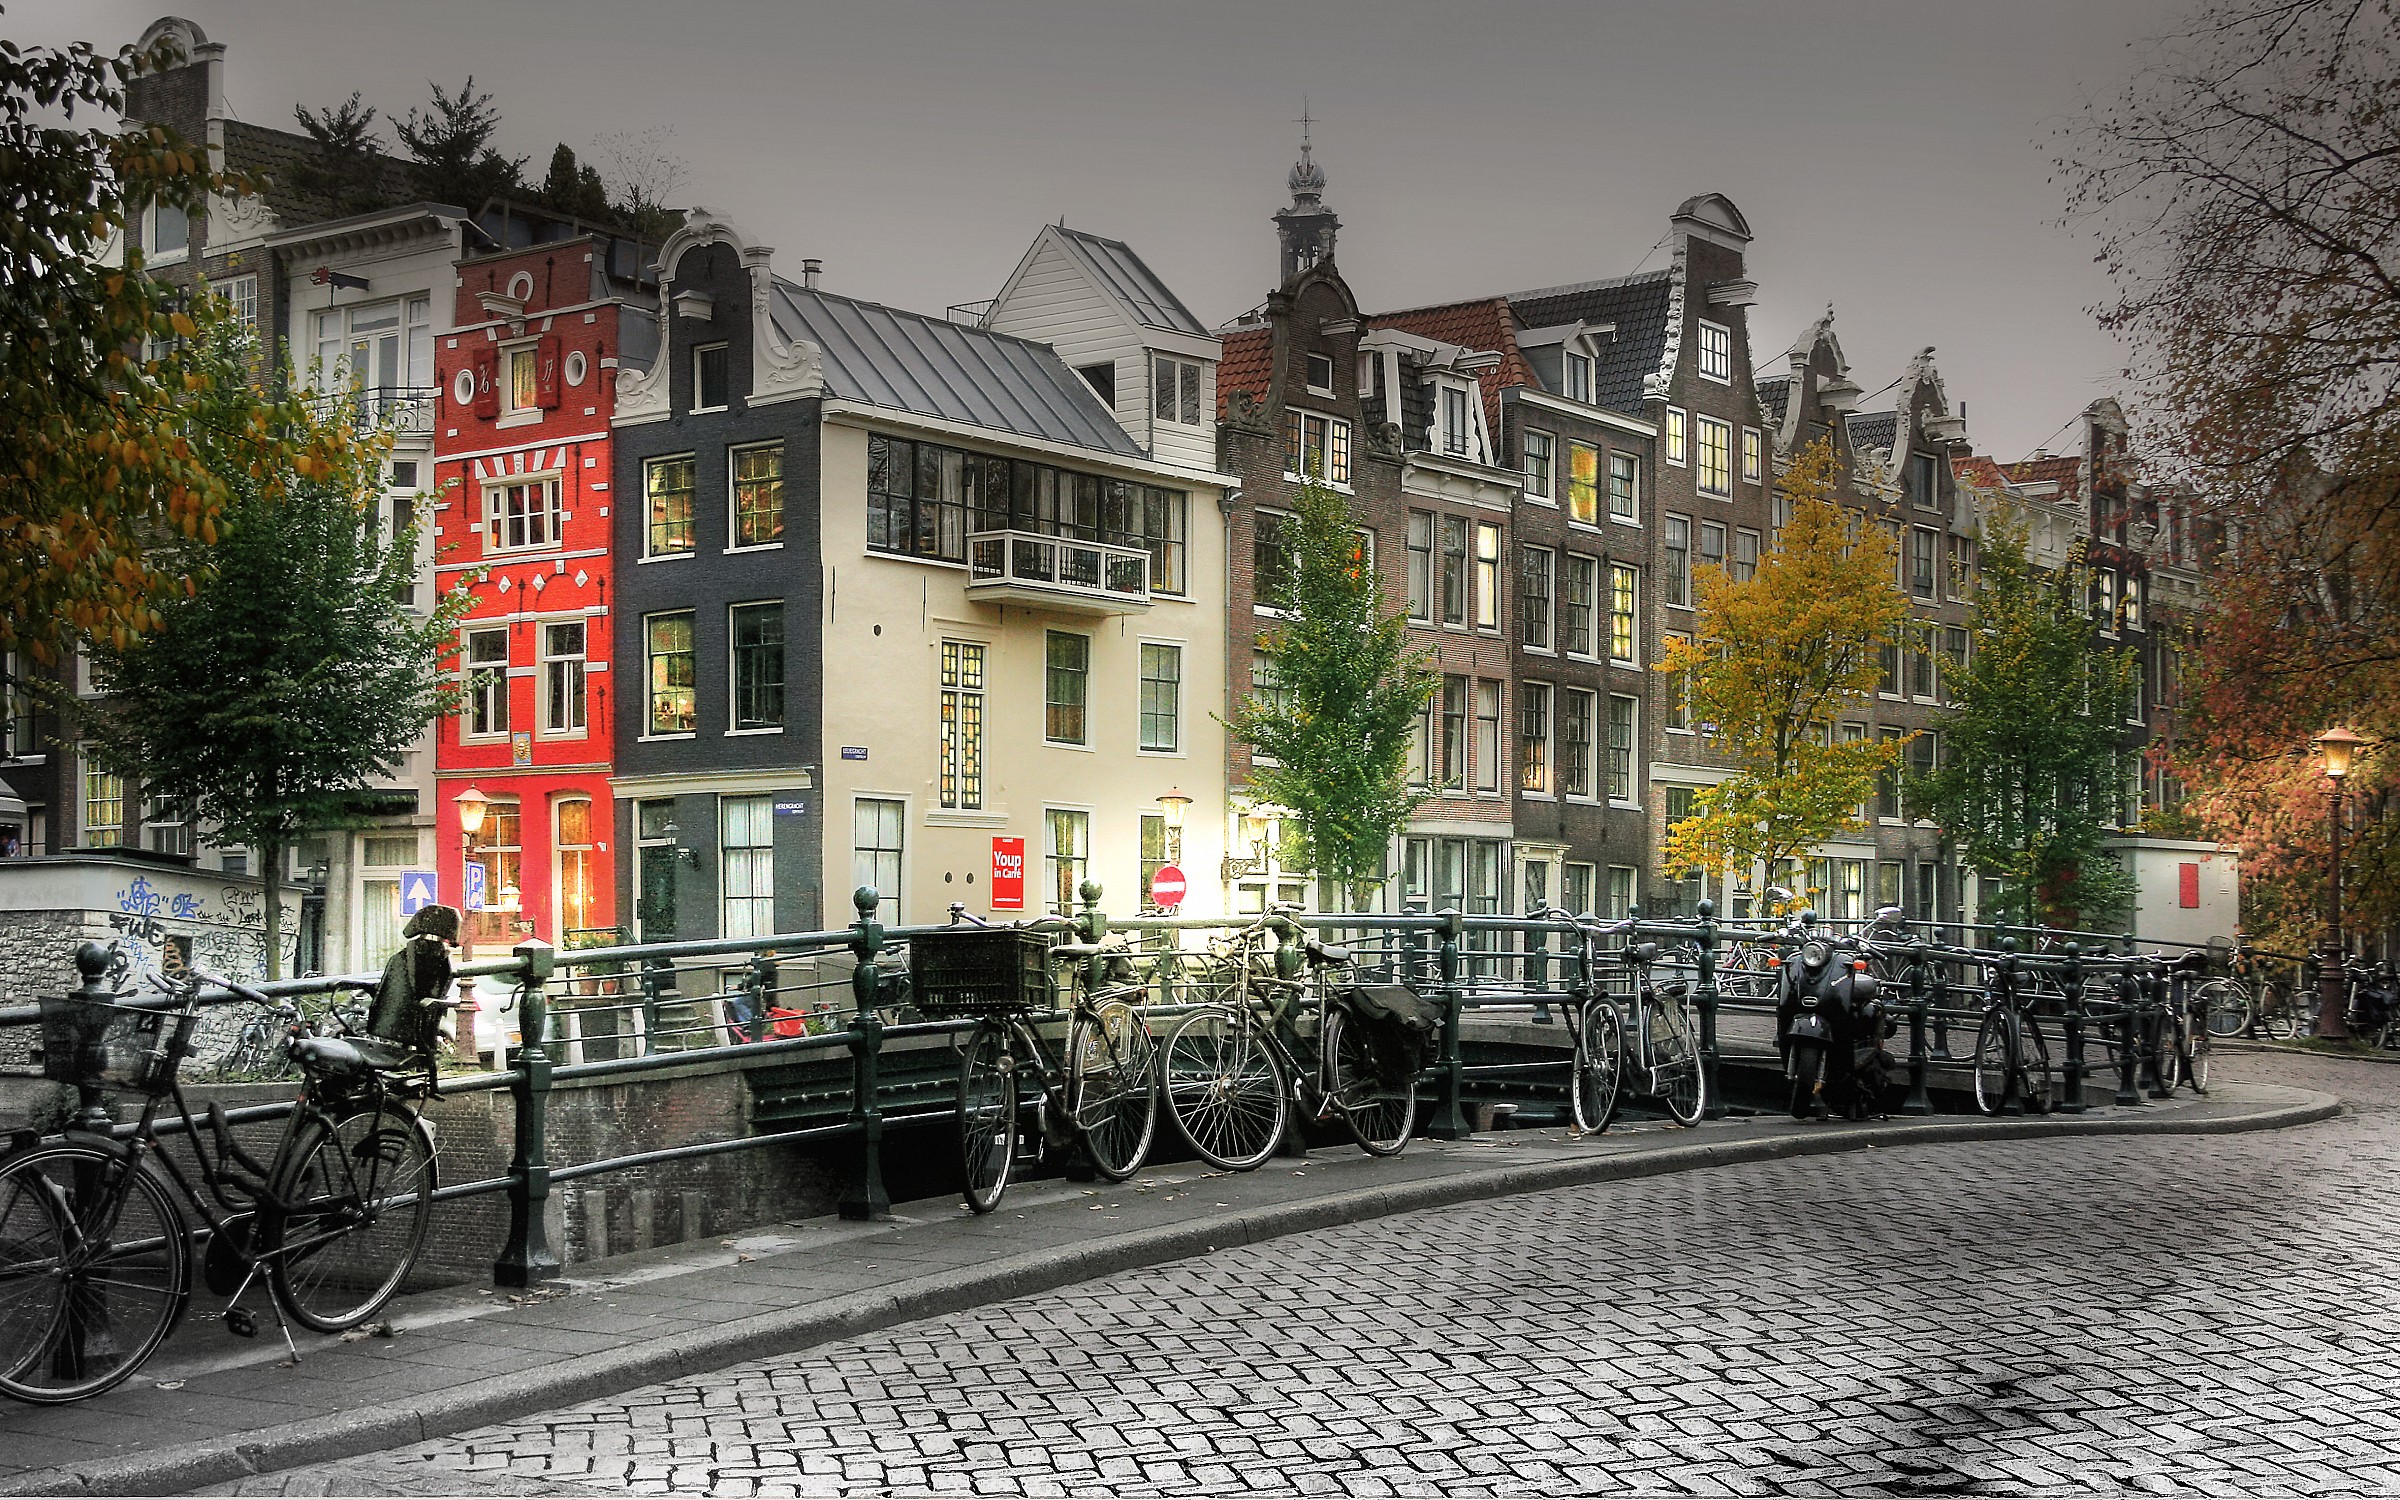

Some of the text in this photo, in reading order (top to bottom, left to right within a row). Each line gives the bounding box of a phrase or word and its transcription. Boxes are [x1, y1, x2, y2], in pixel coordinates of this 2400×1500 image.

[994, 851, 1022, 872] Youp
[471, 867, 482, 891] P
[994, 868, 1002, 878] in
